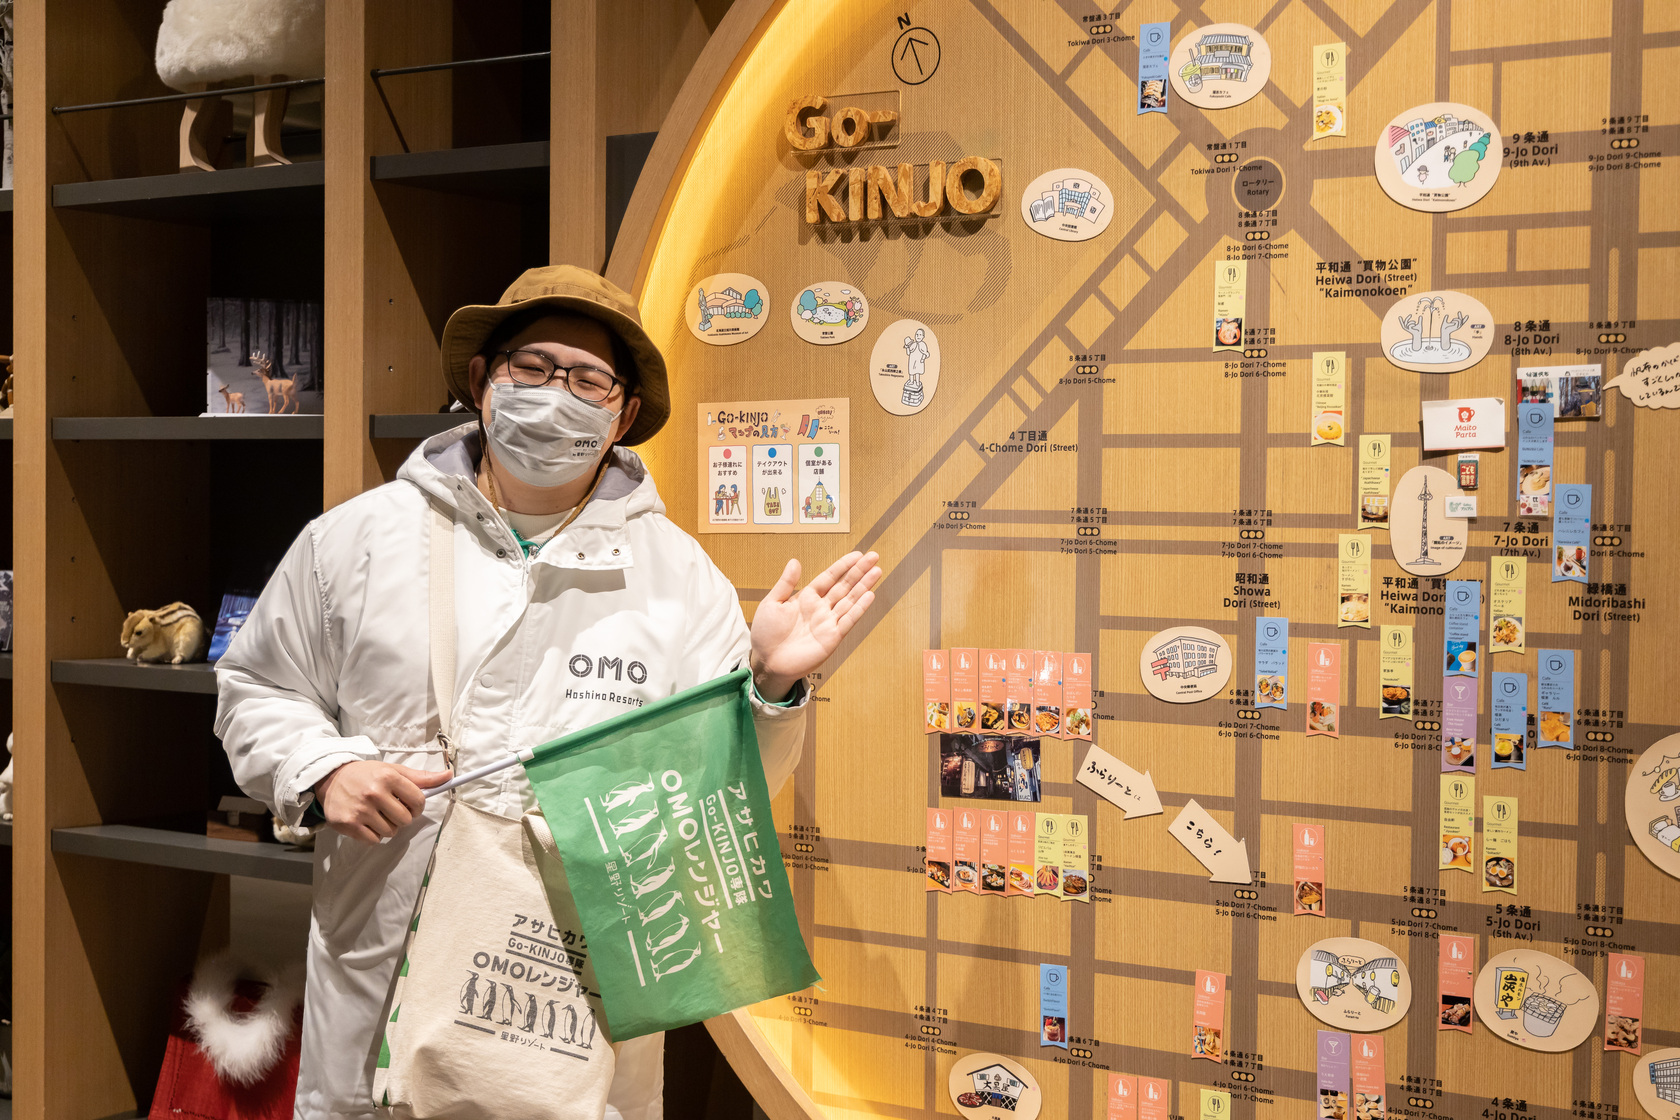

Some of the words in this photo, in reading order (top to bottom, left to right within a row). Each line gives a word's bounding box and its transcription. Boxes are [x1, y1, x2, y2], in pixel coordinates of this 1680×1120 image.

[897, 12, 911, 30] N
[1067, 38, 1089, 47] Tokiwa
[1090, 37, 1106, 46] Dori
[1107, 34, 1135, 44] 3-Chome
[784, 94, 898, 151] Go-
[1512, 131, 1549, 144] 9条通
[1503, 146, 1527, 158] 9-Jo
[1530, 144, 1558, 156] Dori
[1588, 154, 1604, 162] 9-Jo
[1606, 153, 1623, 162] Dori
[1625, 151, 1661, 160] 9-Chome
[1191, 167, 1214, 175] Tokiwa
[1216, 166, 1231, 174] Dori
[1232, 163, 1262, 172] 1-Chome
[1509, 159, 1529, 169] (9th
[1532, 157, 1551, 168] Av.)
[805, 155, 1002, 224] KINJO
[1242, 179, 1274, 188] ロータリー
[1247, 188, 1270, 198] Rotary
[1226, 244, 1240, 252] 8-Jo
[1242, 243, 1256, 251] Dori
[1258, 242, 1289, 250] 6-Chome
[1315, 261, 1352, 274] 平和通
[1315, 274, 1352, 286] Heiwa
[1355, 273, 1380, 285] Dori
[1384, 272, 1418, 283] (Street)
[1514, 320, 1551, 332] 8条通
[1504, 335, 1529, 347] 8-Jo
[1533, 333, 1560, 345] Dori
[1511, 347, 1531, 357] (8th
[1533, 346, 1552, 356] Av.)
[1224, 362, 1238, 370] 8-Jo
[1240, 361, 1254, 369] Dori
[1256, 360, 1287, 368] 7-Chome
[1059, 377, 1072, 385] 8-Jo
[1087, 376, 1116, 384] 5-Chome
[1454, 424, 1477, 432] Maito
[1009, 431, 1048, 442] 4丁目通
[574, 440, 598, 448] OMO
[979, 443, 1024, 453] 4-Chome
[1026, 443, 1047, 452] Dori
[1050, 444, 1078, 453] (Street)
[1504, 522, 1539, 534] 7条通
[1222, 542, 1235, 550] 7-Jo
[1236, 542, 1250, 550] Dori
[1252, 542, 1283, 550] 7-Chome
[1493, 536, 1518, 548] 7-Jo
[1522, 536, 1548, 547] Dori
[1500, 548, 1520, 557] (7th
[1522, 548, 1541, 558] Av.)
[1590, 550, 1608, 558] Dori
[1609, 550, 1645, 558] 8-Chome
[1234, 573, 1270, 585] 昭和通
[1382, 577, 1419, 590] 平和通
[1233, 586, 1271, 597] Showa
[1380, 590, 1418, 602] Heiwa
[1422, 592, 1446, 602] Dori
[1586, 583, 1627, 596] 緑橋通
[1223, 598, 1246, 609] Dori
[1249, 600, 1281, 610] (Street)
[1568, 596, 1646, 610] Midoribashi
[1572, 610, 1600, 622] Dori
[1603, 612, 1640, 623] (Street)
[568, 653, 648, 685] OMO
[565, 688, 607, 702] Hoshino
[608, 691, 644, 708] Resorts
[1218, 721, 1232, 729] 6-Jo
[1250, 722, 1280, 731] 7-Chome
[1566, 754, 1581, 762] 6-Jo
[1582, 754, 1598, 762] Dori
[1600, 756, 1633, 764] 9-Chome
[727, 780, 774, 900] アサヒカワ
[660, 768, 724, 954] OMOレンジャー
[604, 860, 630, 925] 星野リゾート
[1216, 900, 1229, 908] 5-Jo
[1230, 901, 1245, 909] Dori
[1246, 902, 1277, 912] 7-Chome
[1496, 904, 1532, 918] 5条通
[1391, 919, 1406, 928] 5-Jo
[1408, 920, 1424, 929] Dori
[1425, 922, 1458, 932] 7-Chome
[1486, 917, 1510, 930] 5-Jo
[1513, 918, 1540, 932] Dori
[1492, 929, 1512, 940] (5th
[1514, 932, 1534, 942] Av.)
[1564, 937, 1580, 947] 5-Jo
[1581, 938, 1598, 948] Dori
[1600, 940, 1636, 951] 8-Chome
[472, 951, 602, 998] OMOレンジャー
[500, 1031, 546, 1051] 星野リゾート
[905, 1034, 916, 1042] 4-Jo
[918, 1035, 930, 1043] Dori
[932, 1036, 957, 1047] 4-Chome
[1492, 1097, 1528, 1112] 4条通
